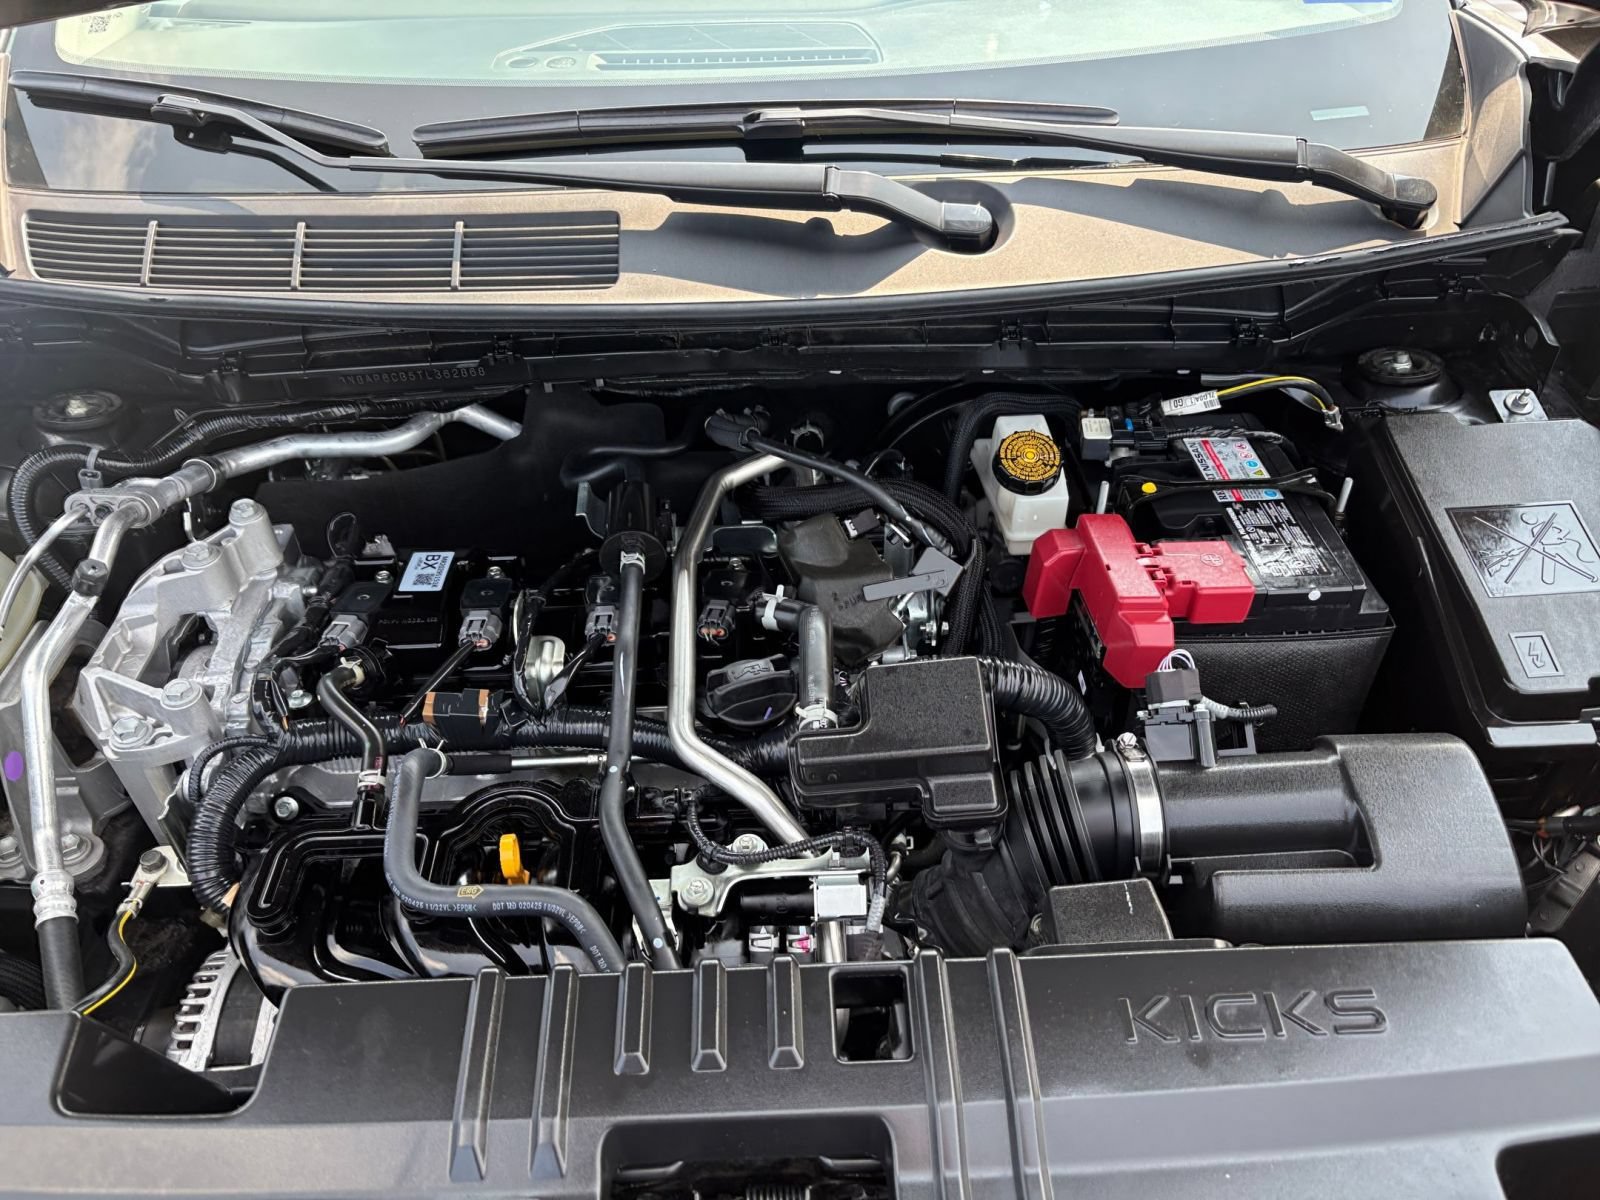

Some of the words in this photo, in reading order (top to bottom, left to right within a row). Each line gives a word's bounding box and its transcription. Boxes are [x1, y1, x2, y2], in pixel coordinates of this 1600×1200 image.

[1188, 441, 1211, 472] NISSAN
[421, 554, 442, 570] BX
[492, 901, 504, 911] DOT
[518, 901, 542, 910] 020425
[590, 945, 601, 958] DOT
[1118, 988, 1389, 1044] KICKS
